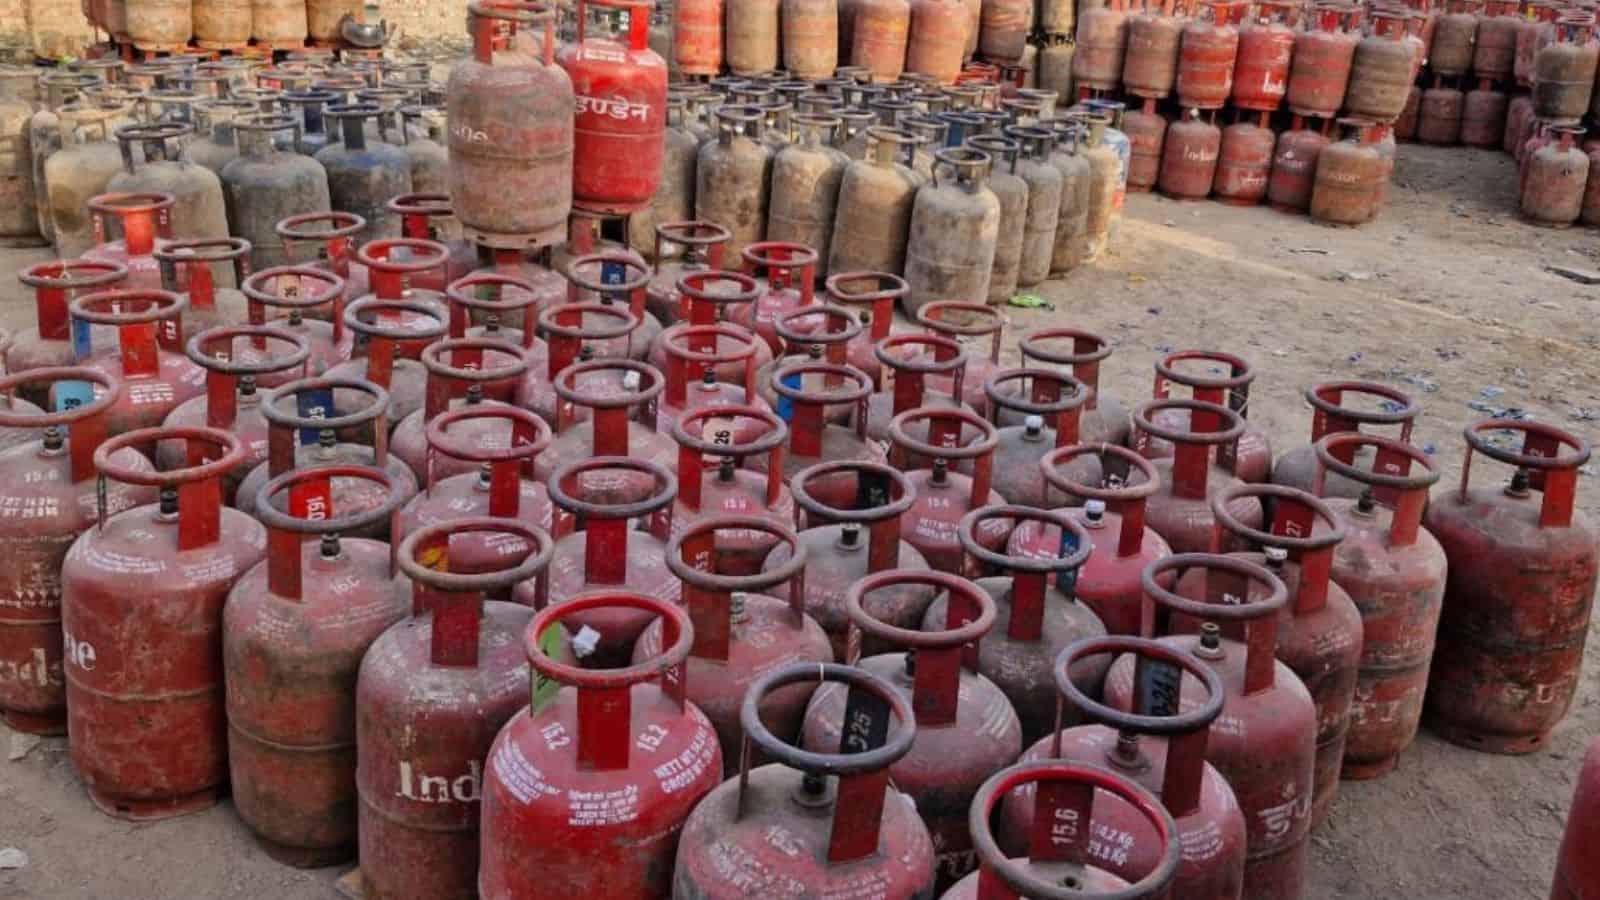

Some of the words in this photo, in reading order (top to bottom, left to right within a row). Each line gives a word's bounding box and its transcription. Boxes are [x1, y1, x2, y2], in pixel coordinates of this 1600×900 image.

[714, 430, 730, 445] 26
[1285, 519, 1303, 539] 27
[394, 759, 481, 803] Ind
[1051, 808, 1079, 845] 15.6
